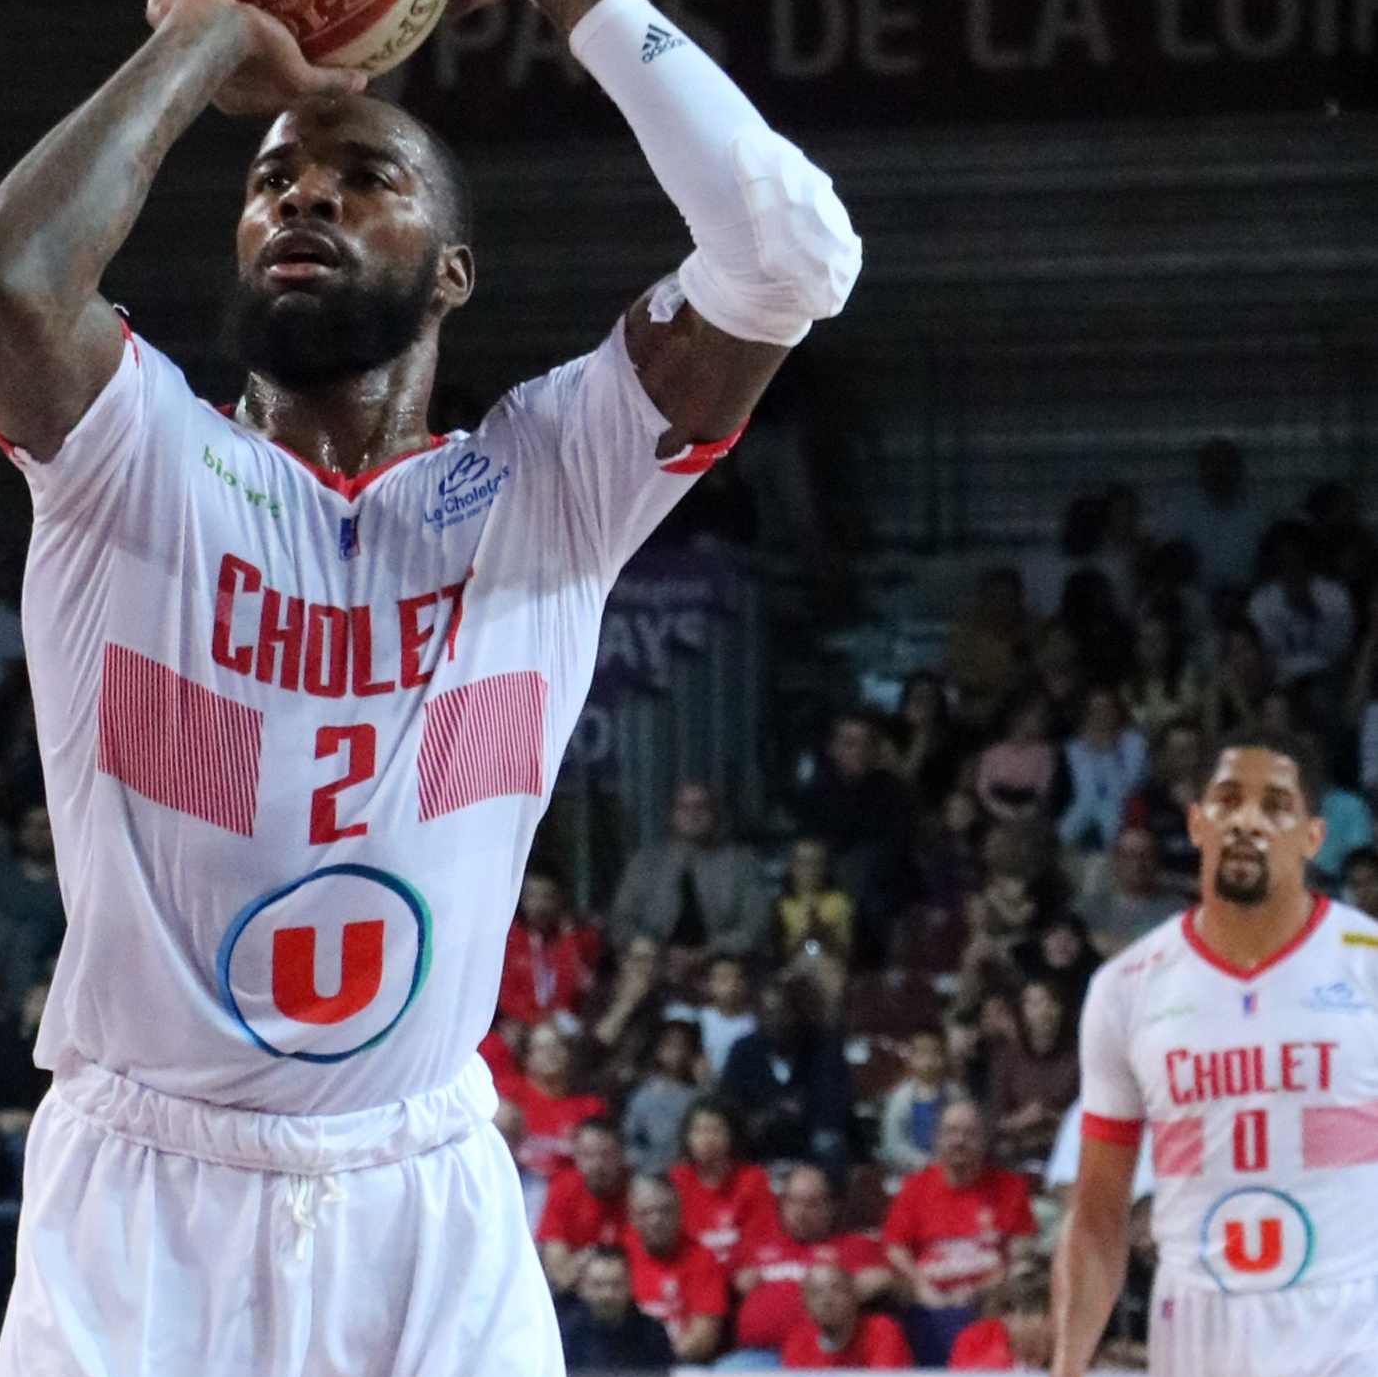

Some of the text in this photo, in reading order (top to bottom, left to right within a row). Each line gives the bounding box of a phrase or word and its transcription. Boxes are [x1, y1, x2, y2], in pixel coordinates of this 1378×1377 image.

[210, 552, 477, 699] CHOLET
[308, 723, 376, 846] 2
[272, 919, 385, 1026] U
[1165, 1041, 1340, 1107] CHOLET
[1233, 1108, 1269, 1173] 0
[1223, 1218, 1283, 1274] U
